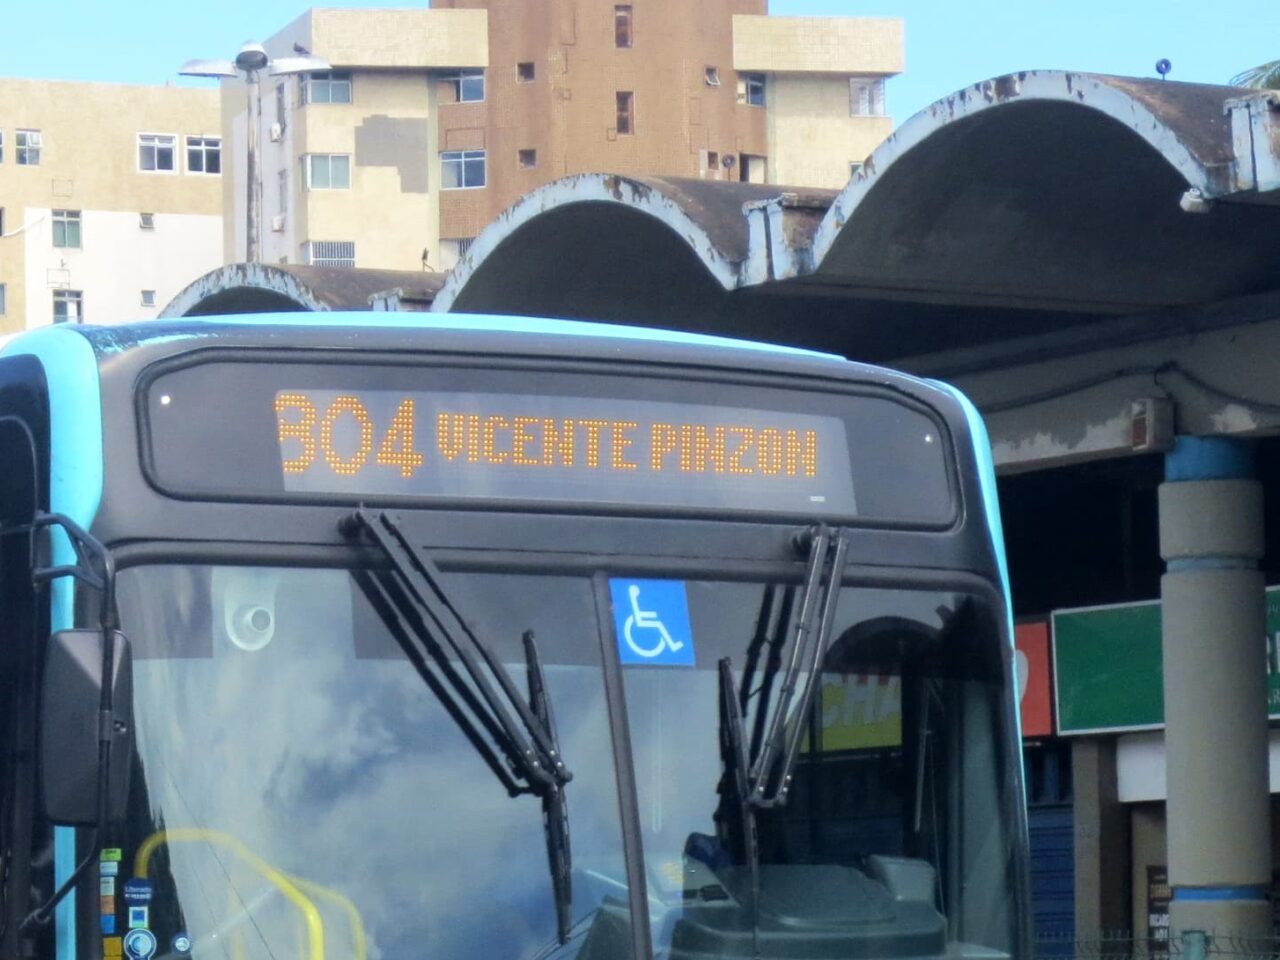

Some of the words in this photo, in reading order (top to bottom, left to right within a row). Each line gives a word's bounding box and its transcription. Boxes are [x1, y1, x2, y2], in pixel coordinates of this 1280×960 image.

[275, 393, 423, 478] 304
[436, 412, 638, 469] VICENTE
[649, 423, 817, 478] PINZON
